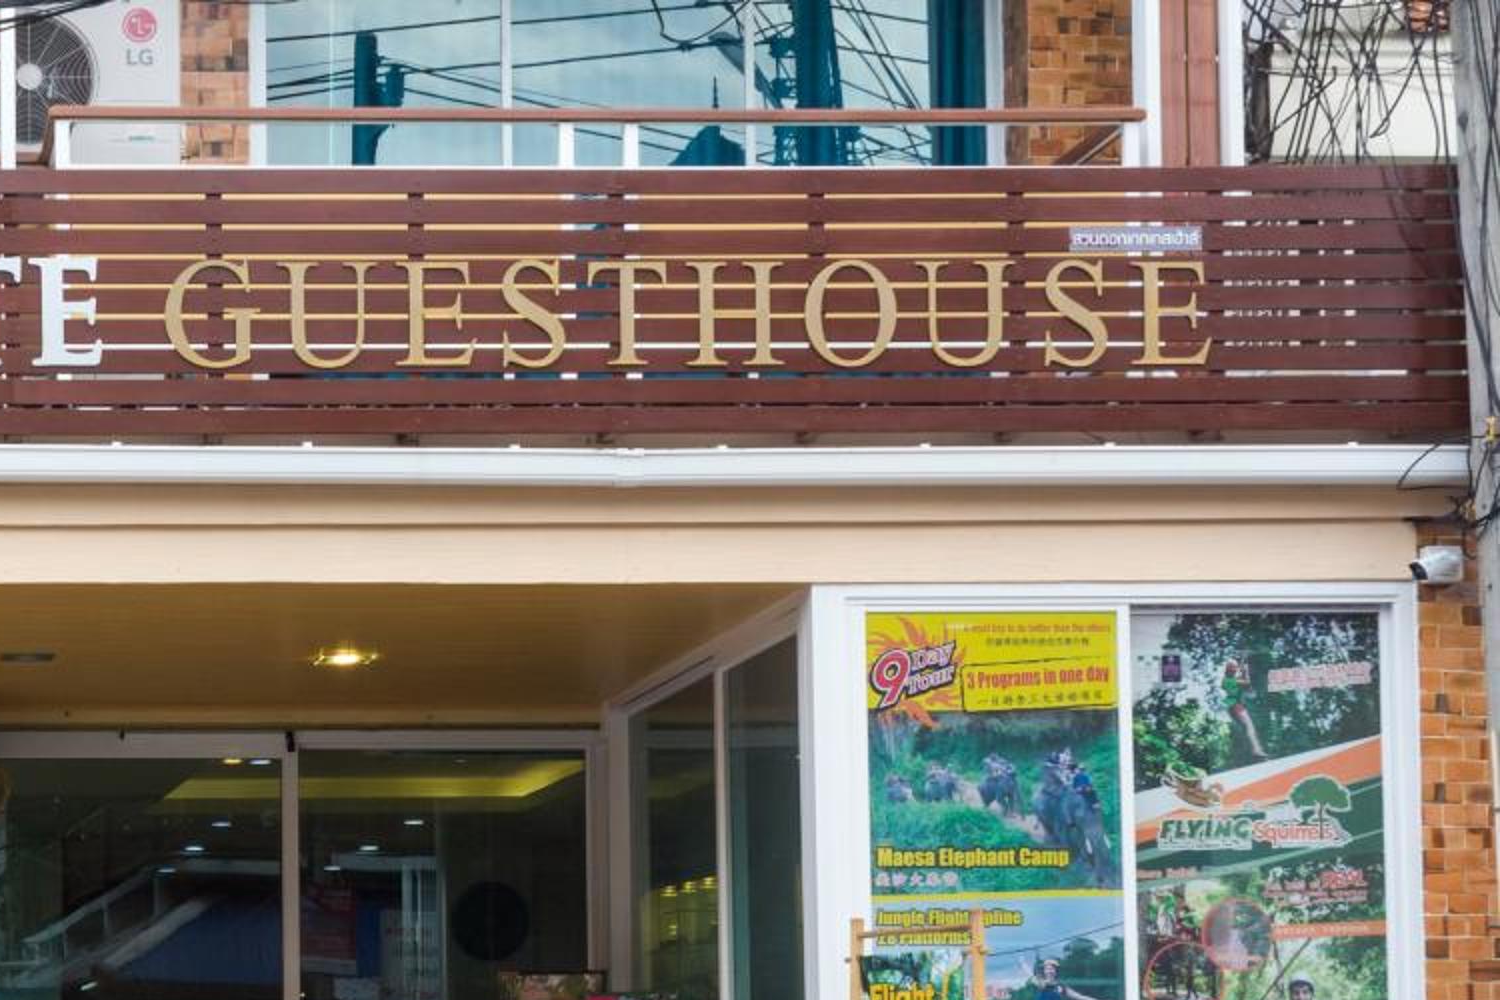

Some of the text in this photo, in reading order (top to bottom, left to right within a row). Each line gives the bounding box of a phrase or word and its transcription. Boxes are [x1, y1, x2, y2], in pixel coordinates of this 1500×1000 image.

[126, 50, 154, 66] LG
[164, 258, 1213, 371] GUESTHOUSE
[877, 847, 1070, 867] Maesa Elephant Camp
